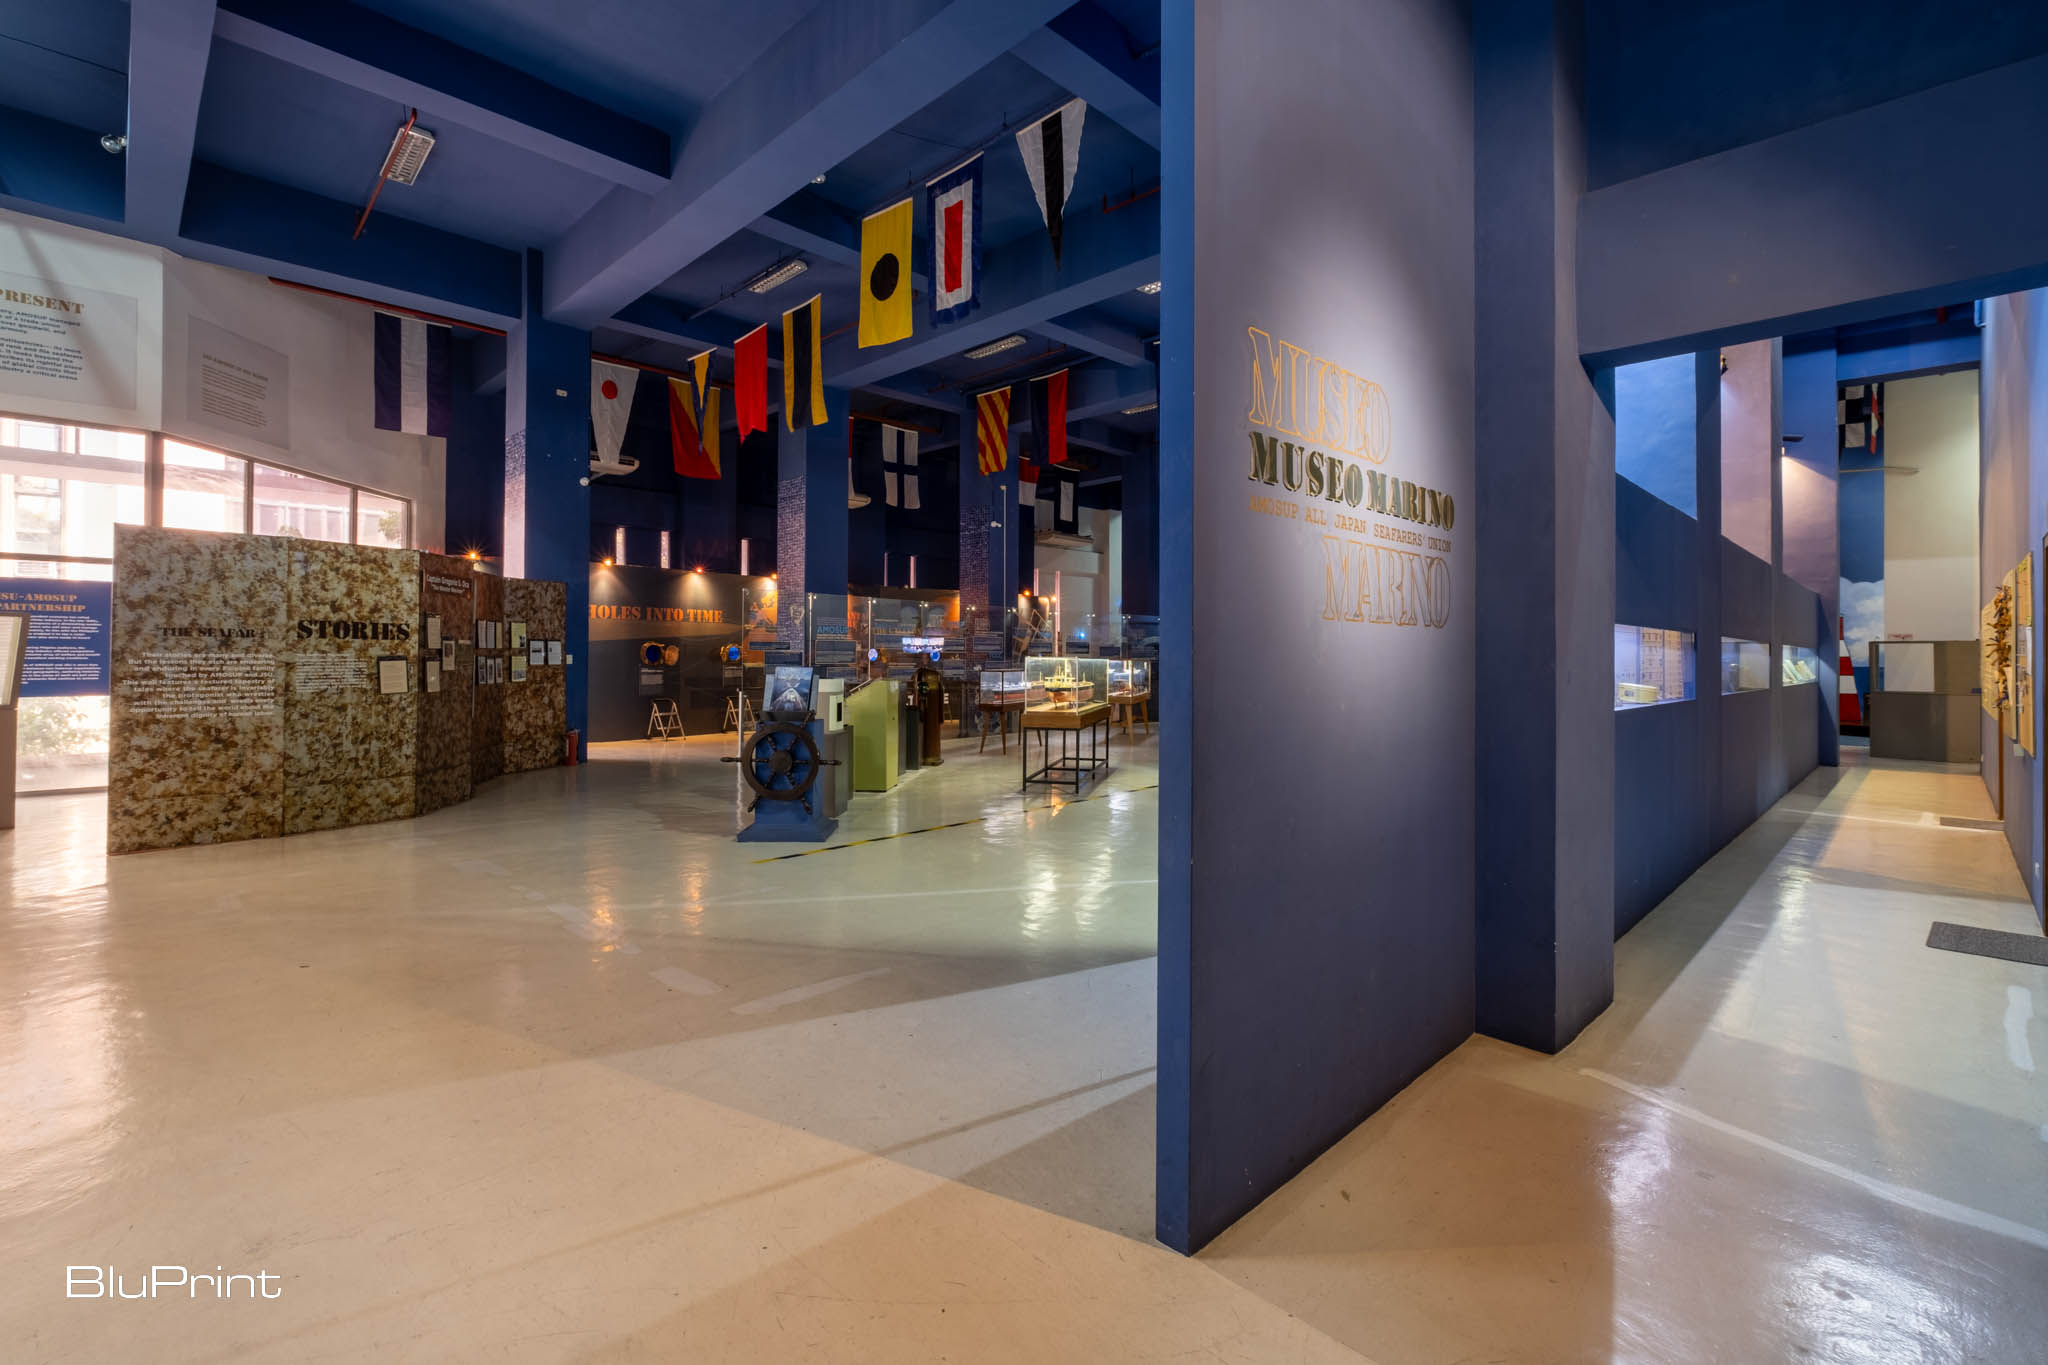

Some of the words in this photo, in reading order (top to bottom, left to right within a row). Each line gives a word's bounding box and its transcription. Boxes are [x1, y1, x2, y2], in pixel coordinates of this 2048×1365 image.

[0, 288, 84, 314] RESENT
[1248, 326, 1391, 464] MUSEO
[1248, 431, 1363, 508] MUSEO
[1367, 469, 1455, 531] MARINO
[1249, 496, 1299, 520] AMOSUP
[1305, 507, 1326, 527] ALL
[1334, 513, 1366, 535] JAPAN
[1428, 536, 1452, 553] UNION
[1322, 535, 1452, 629] MARINO
[0, 592, 77, 602] SU-AMOSUP
[0, 602, 85, 612] ARTNERSHIP
[646, 607, 684, 622] INTO
[687, 609, 724, 624] TIME
[162, 627, 193, 637] THE
[297, 620, 410, 640] STORIES
